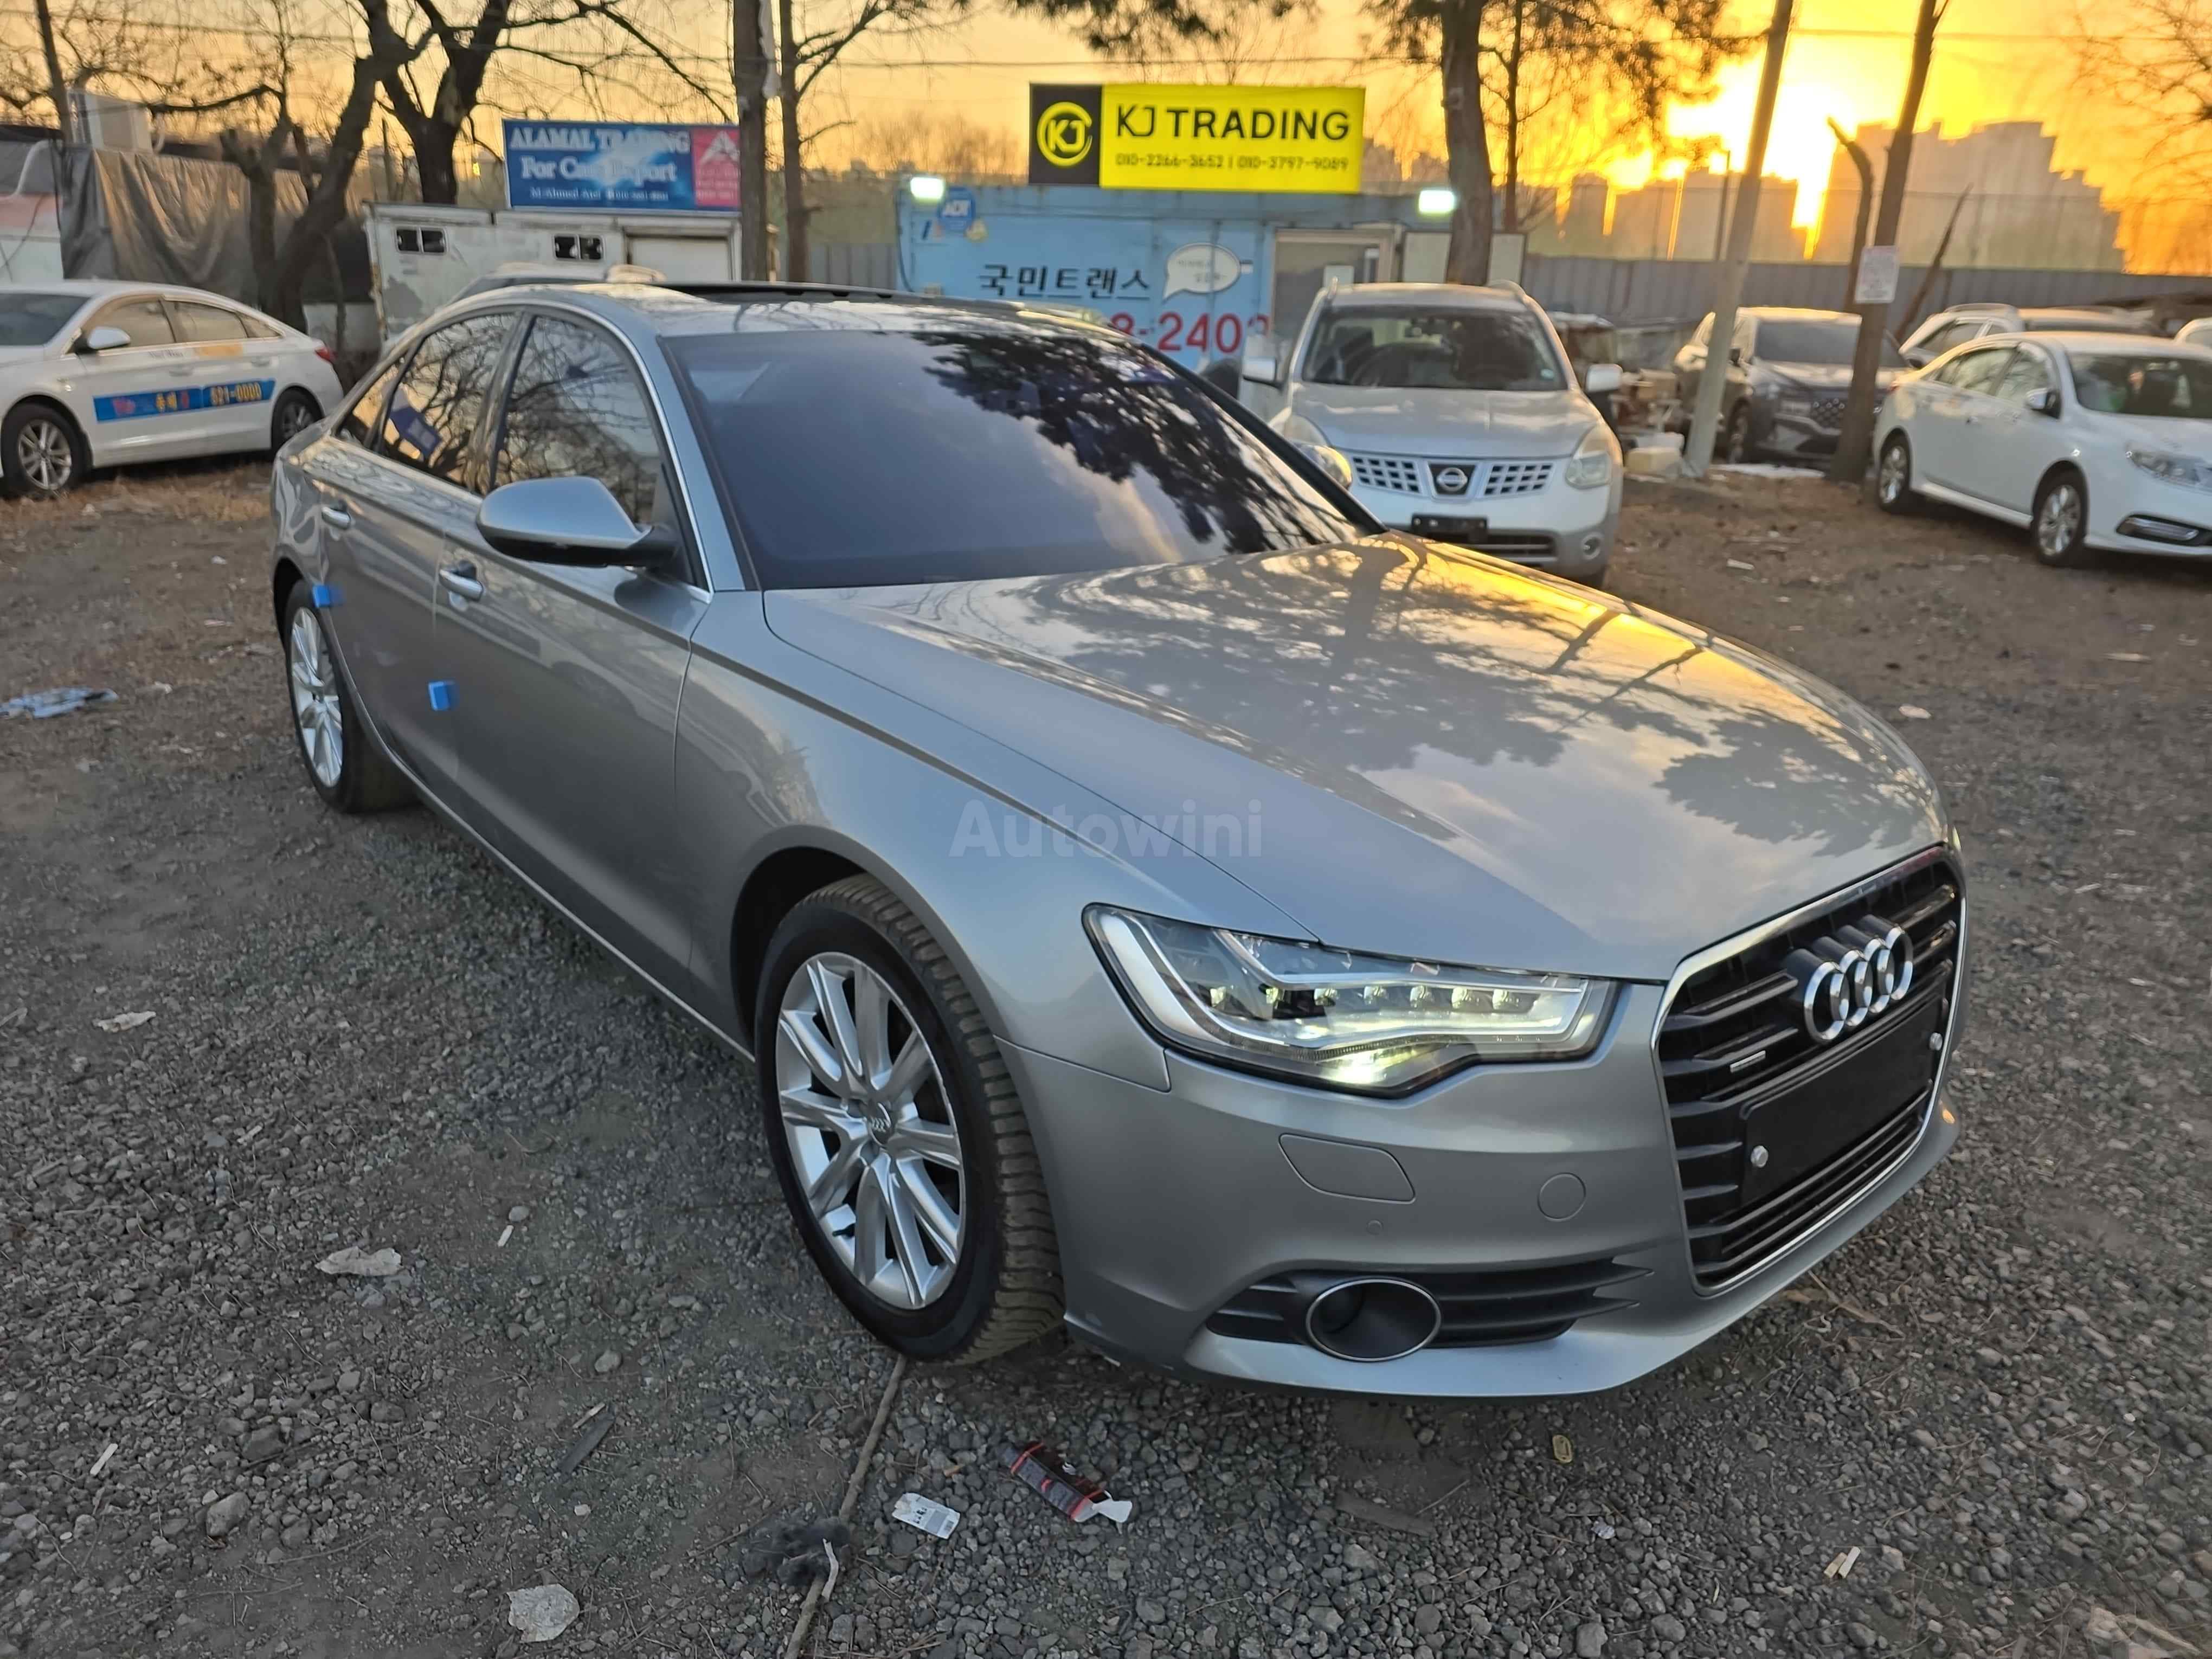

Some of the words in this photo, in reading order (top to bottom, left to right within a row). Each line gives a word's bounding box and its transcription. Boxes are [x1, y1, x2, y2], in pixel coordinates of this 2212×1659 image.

[1116, 105, 1155, 138] KJ
[1166, 108, 1350, 140] TRADING
[521, 155, 556, 179] For
